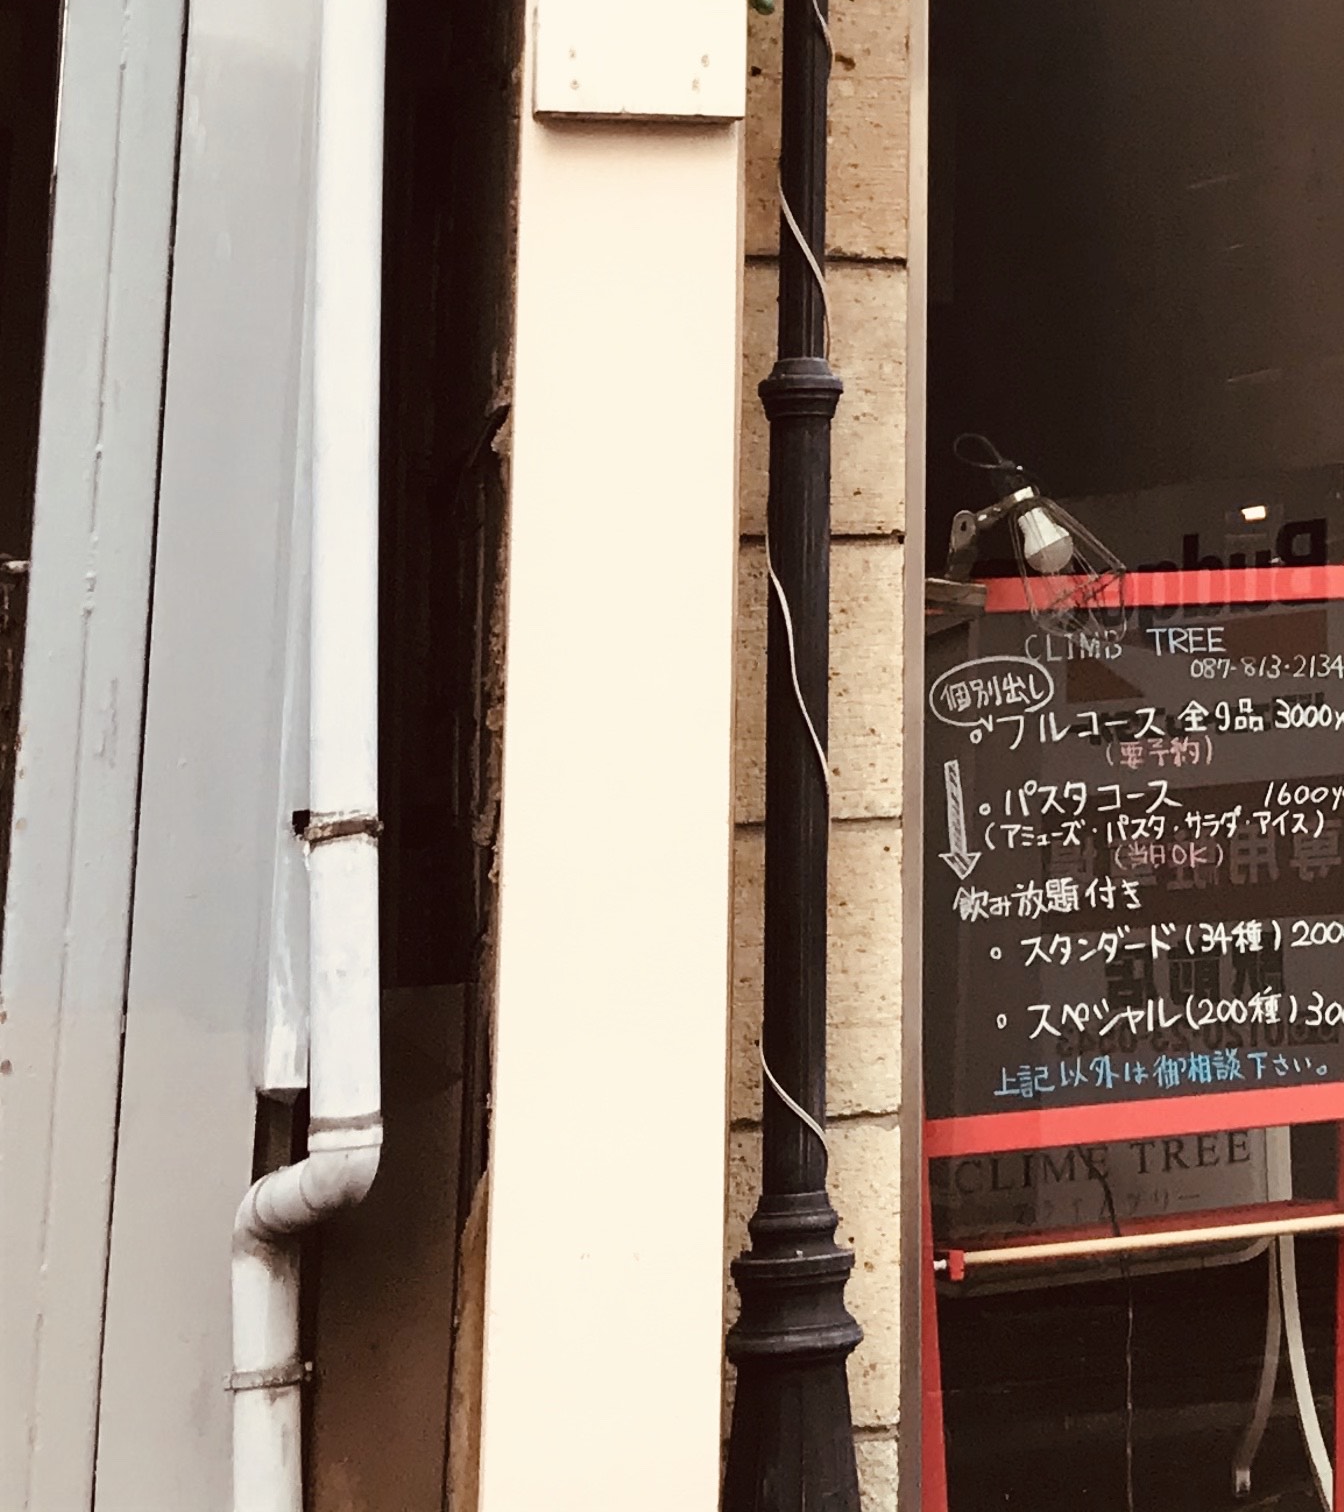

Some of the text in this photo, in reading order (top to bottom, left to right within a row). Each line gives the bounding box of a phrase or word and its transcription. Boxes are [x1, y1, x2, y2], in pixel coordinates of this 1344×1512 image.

[1146, 626, 1227, 656] TREE
[1178, 697, 1264, 733] 全9品
[953, 876, 1143, 920] 飲み放題付き
[1130, 1133, 1252, 1175] TREE
